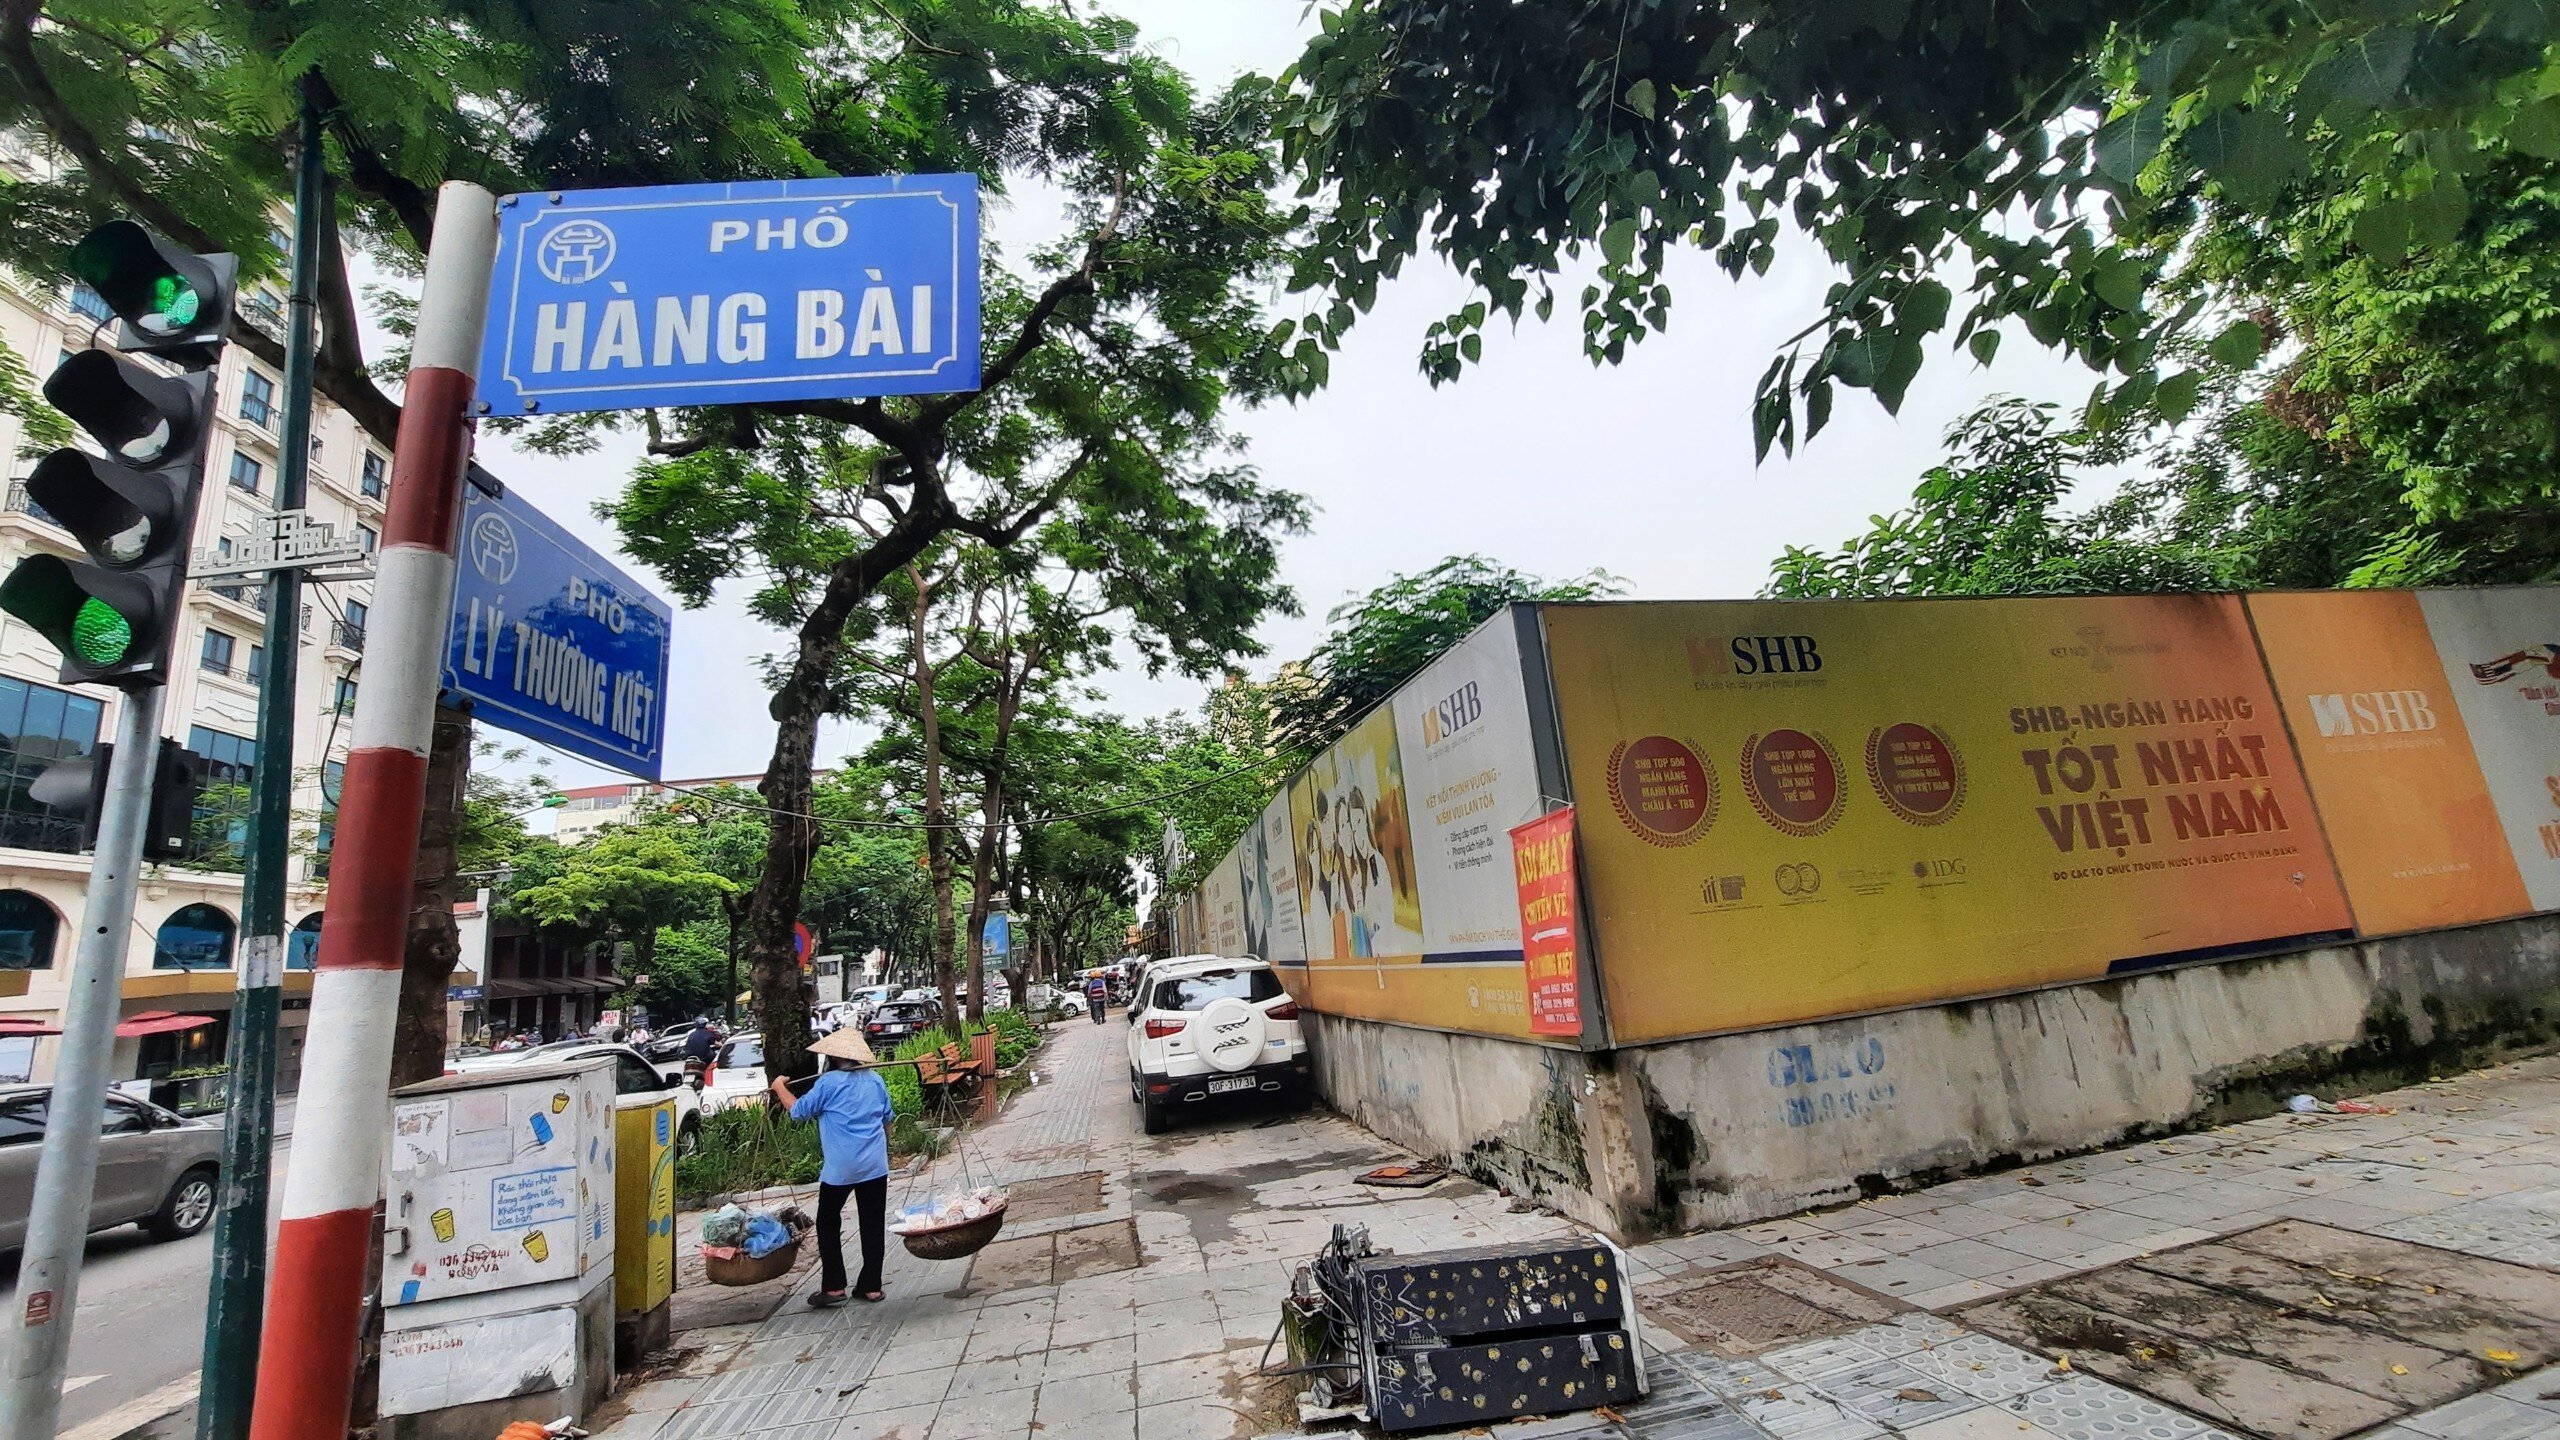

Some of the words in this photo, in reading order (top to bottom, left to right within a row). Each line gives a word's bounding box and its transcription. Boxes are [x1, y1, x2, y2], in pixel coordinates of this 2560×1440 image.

[708, 200, 856, 253] PHỐ
[531, 280, 767, 374] HÀNG
[795, 268, 932, 360] BÀI
[567, 574, 628, 635] PHỐ
[463, 594, 505, 681] LÝ
[513, 620, 608, 727] THƯỜNG
[611, 670, 654, 753] KIỆT
[1731, 635, 1823, 675] SHB
[1439, 681, 1481, 739] SHB
[2352, 691, 2437, 735] SHB
[1652, 758, 1668, 768] TOP
[1670, 757, 1685, 767] 500
[2021, 730, 2122, 795] TỐT
[2135, 722, 2271, 786] NHẤT
[2035, 791, 2152, 858] VIỆT
[2165, 787, 2290, 841] NAM
[1932, 858, 1966, 877] IDG
